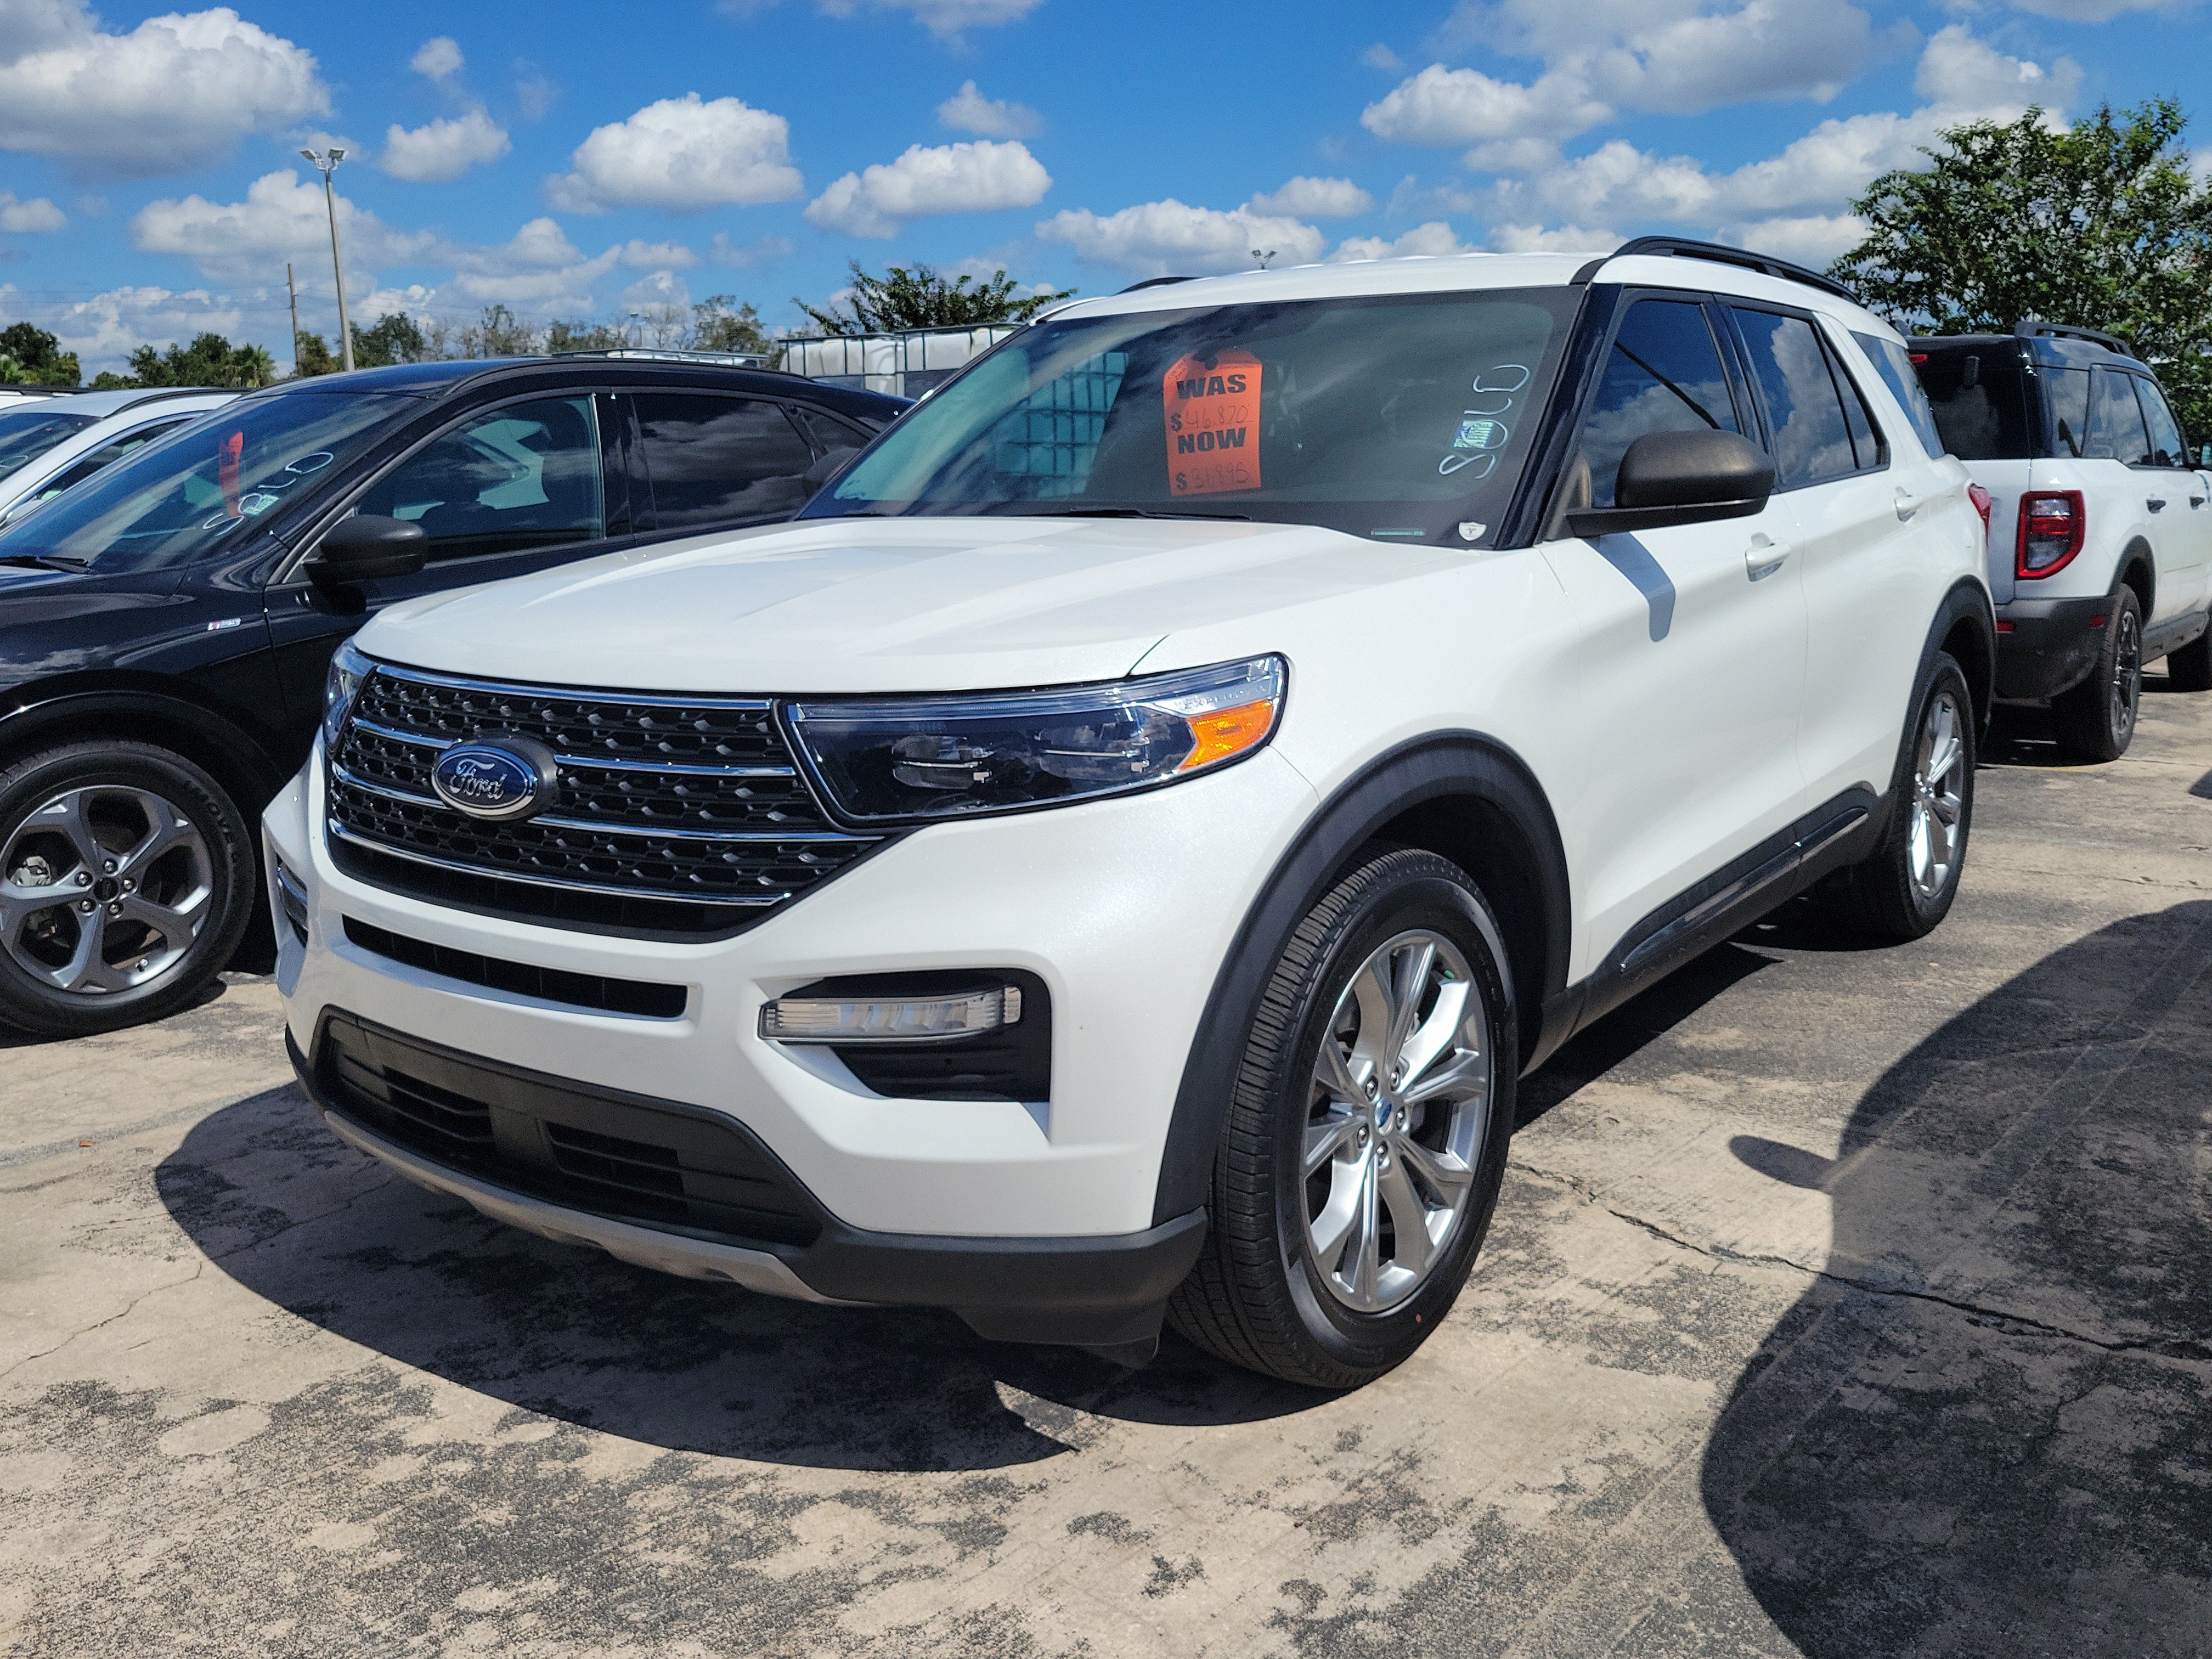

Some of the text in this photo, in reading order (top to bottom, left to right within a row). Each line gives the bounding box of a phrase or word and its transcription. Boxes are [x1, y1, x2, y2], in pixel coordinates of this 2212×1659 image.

[1176, 374, 1246, 399] WAS
[1177, 427, 1247, 455] NOW
[449, 758, 508, 800] Ford
